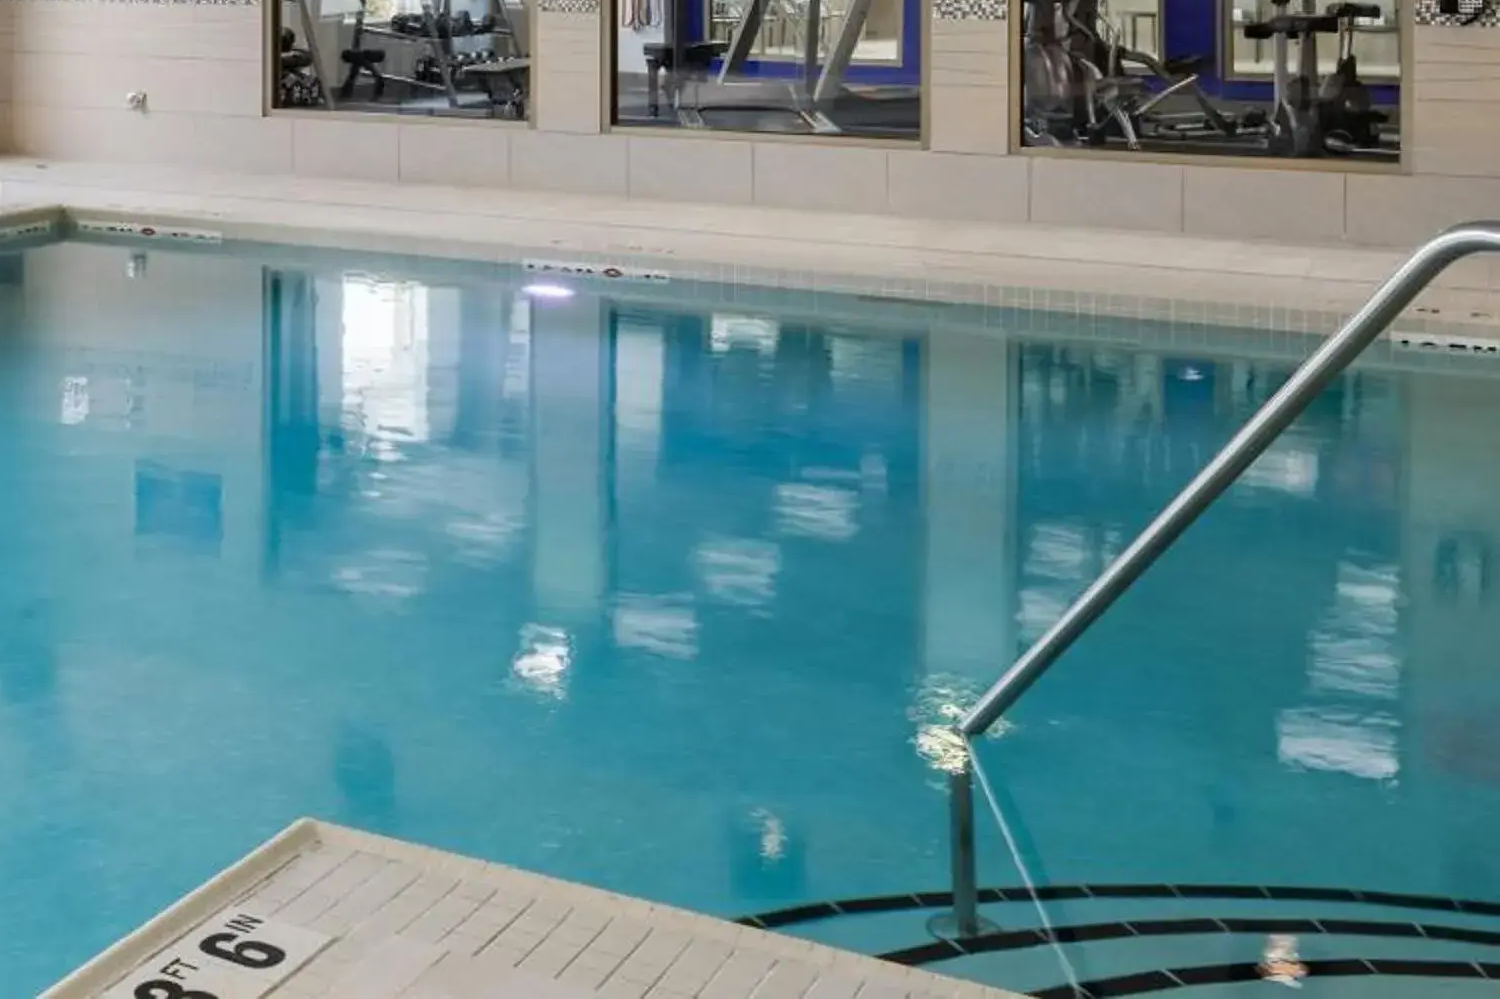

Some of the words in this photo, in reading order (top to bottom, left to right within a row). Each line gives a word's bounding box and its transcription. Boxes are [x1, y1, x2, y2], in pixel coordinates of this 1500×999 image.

[224, 913, 264, 933] IN
[198, 932, 286, 969] 6
[159, 957, 199, 980] FT
